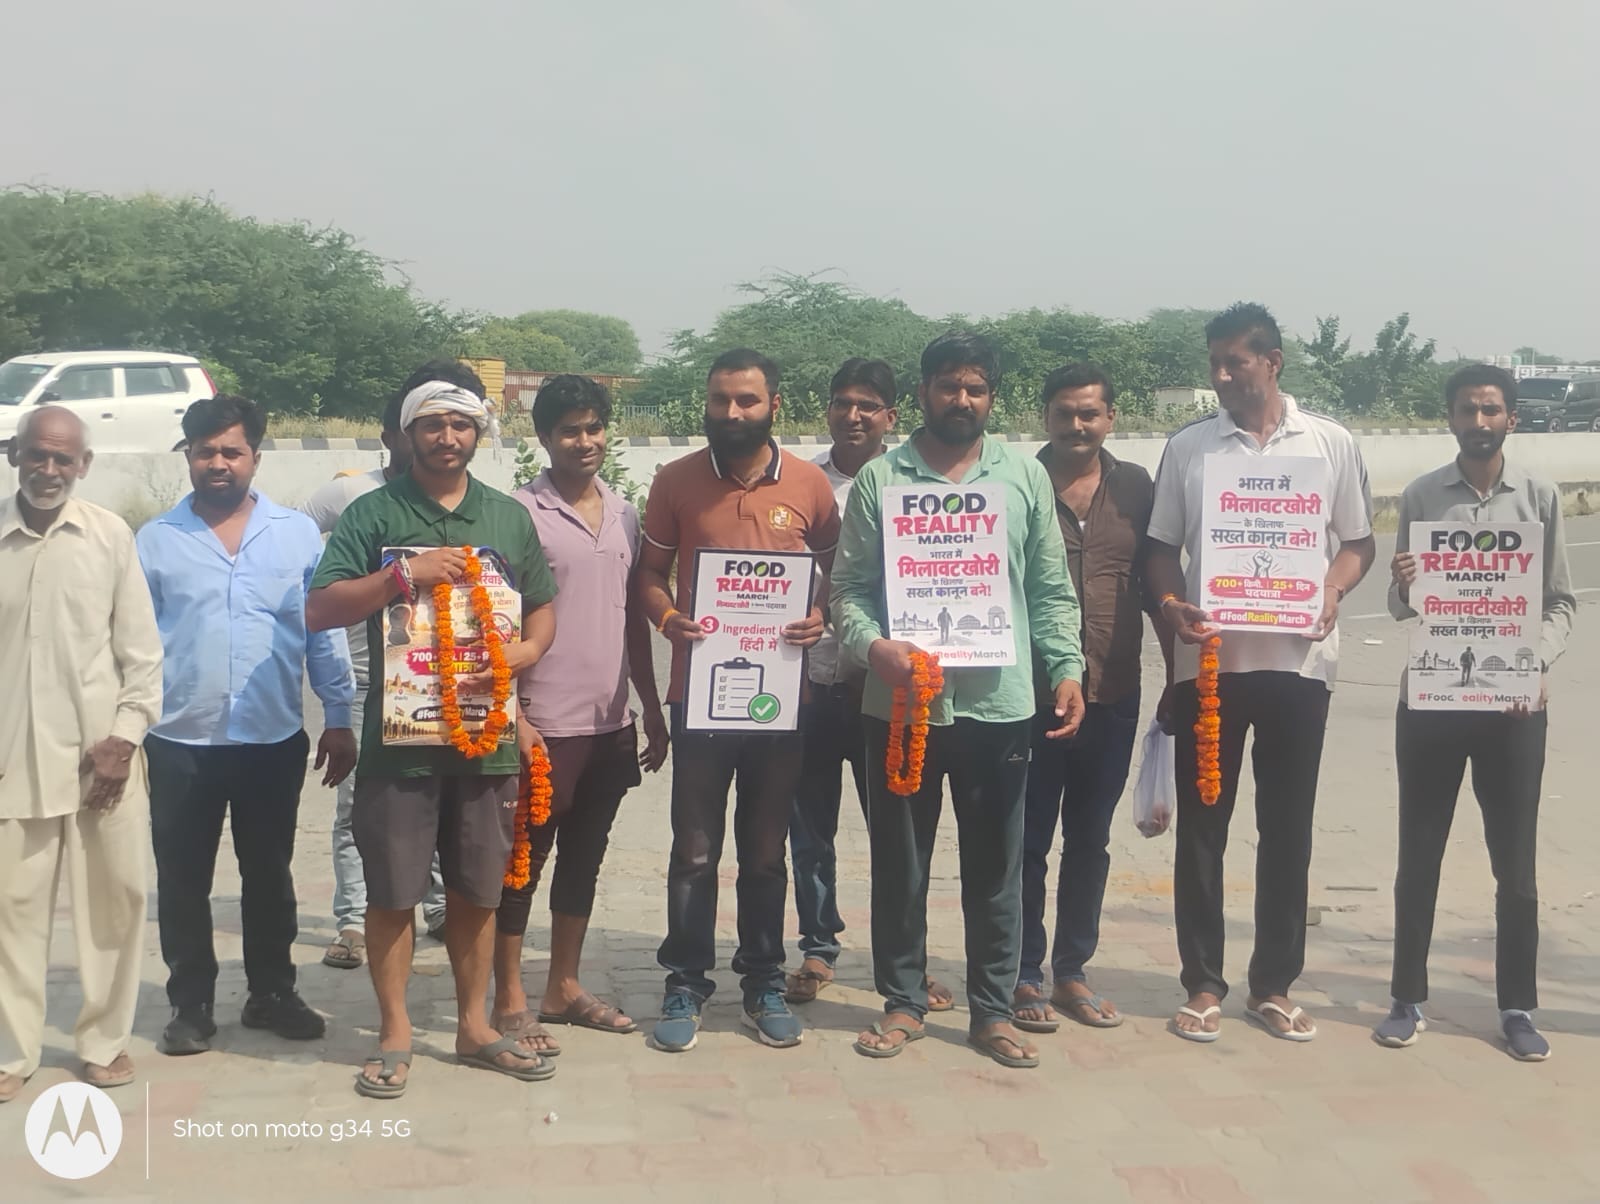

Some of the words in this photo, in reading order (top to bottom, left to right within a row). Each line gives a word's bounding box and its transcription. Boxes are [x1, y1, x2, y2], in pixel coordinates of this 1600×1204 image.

[1239, 477, 1275, 491] भारत
[1278, 475, 1292, 491] में
[902, 493, 987, 515] FOOD
[1220, 491, 1321, 514] मिलावटखोरी
[892, 514, 998, 537] REALITY
[1244, 518, 1252, 528] के
[918, 534, 974, 544] MARCH
[1211, 529, 1245, 543] सख्त
[1247, 530, 1287, 549] कानून
[1289, 528, 1317, 548] बने!
[1431, 530, 1522, 552] FOOD
[930, 550, 953, 559] भारत
[955, 548, 963, 558] में
[724, 560, 785, 577] FOOD
[897, 553, 1000, 577] मिलावटखोरी
[1420, 552, 1534, 574] REALITY
[1215, 578, 1243, 588] 700+
[1272, 580, 1294, 590] 25+
[1445, 573, 1506, 582] MARCH
[716, 577, 792, 595] REALITY
[906, 588, 933, 598] सख्त
[935, 586, 968, 600] कानून
[970, 583, 991, 598] बने!
[1458, 588, 1482, 597] भारत
[1485, 586, 1493, 597] में
[1424, 595, 1528, 616] मिलावटीखोरी
[705, 618, 714, 630] 3
[1219, 611, 1306, 625] #FoodRealityMarch
[723, 624, 776, 636] Ingredient
[1430, 625, 1458, 636] सख्त
[1461, 625, 1496, 639] कानून
[1498, 623, 1521, 637] बने!
[739, 637, 764, 651] हिंदी
[768, 637, 778, 651] में
